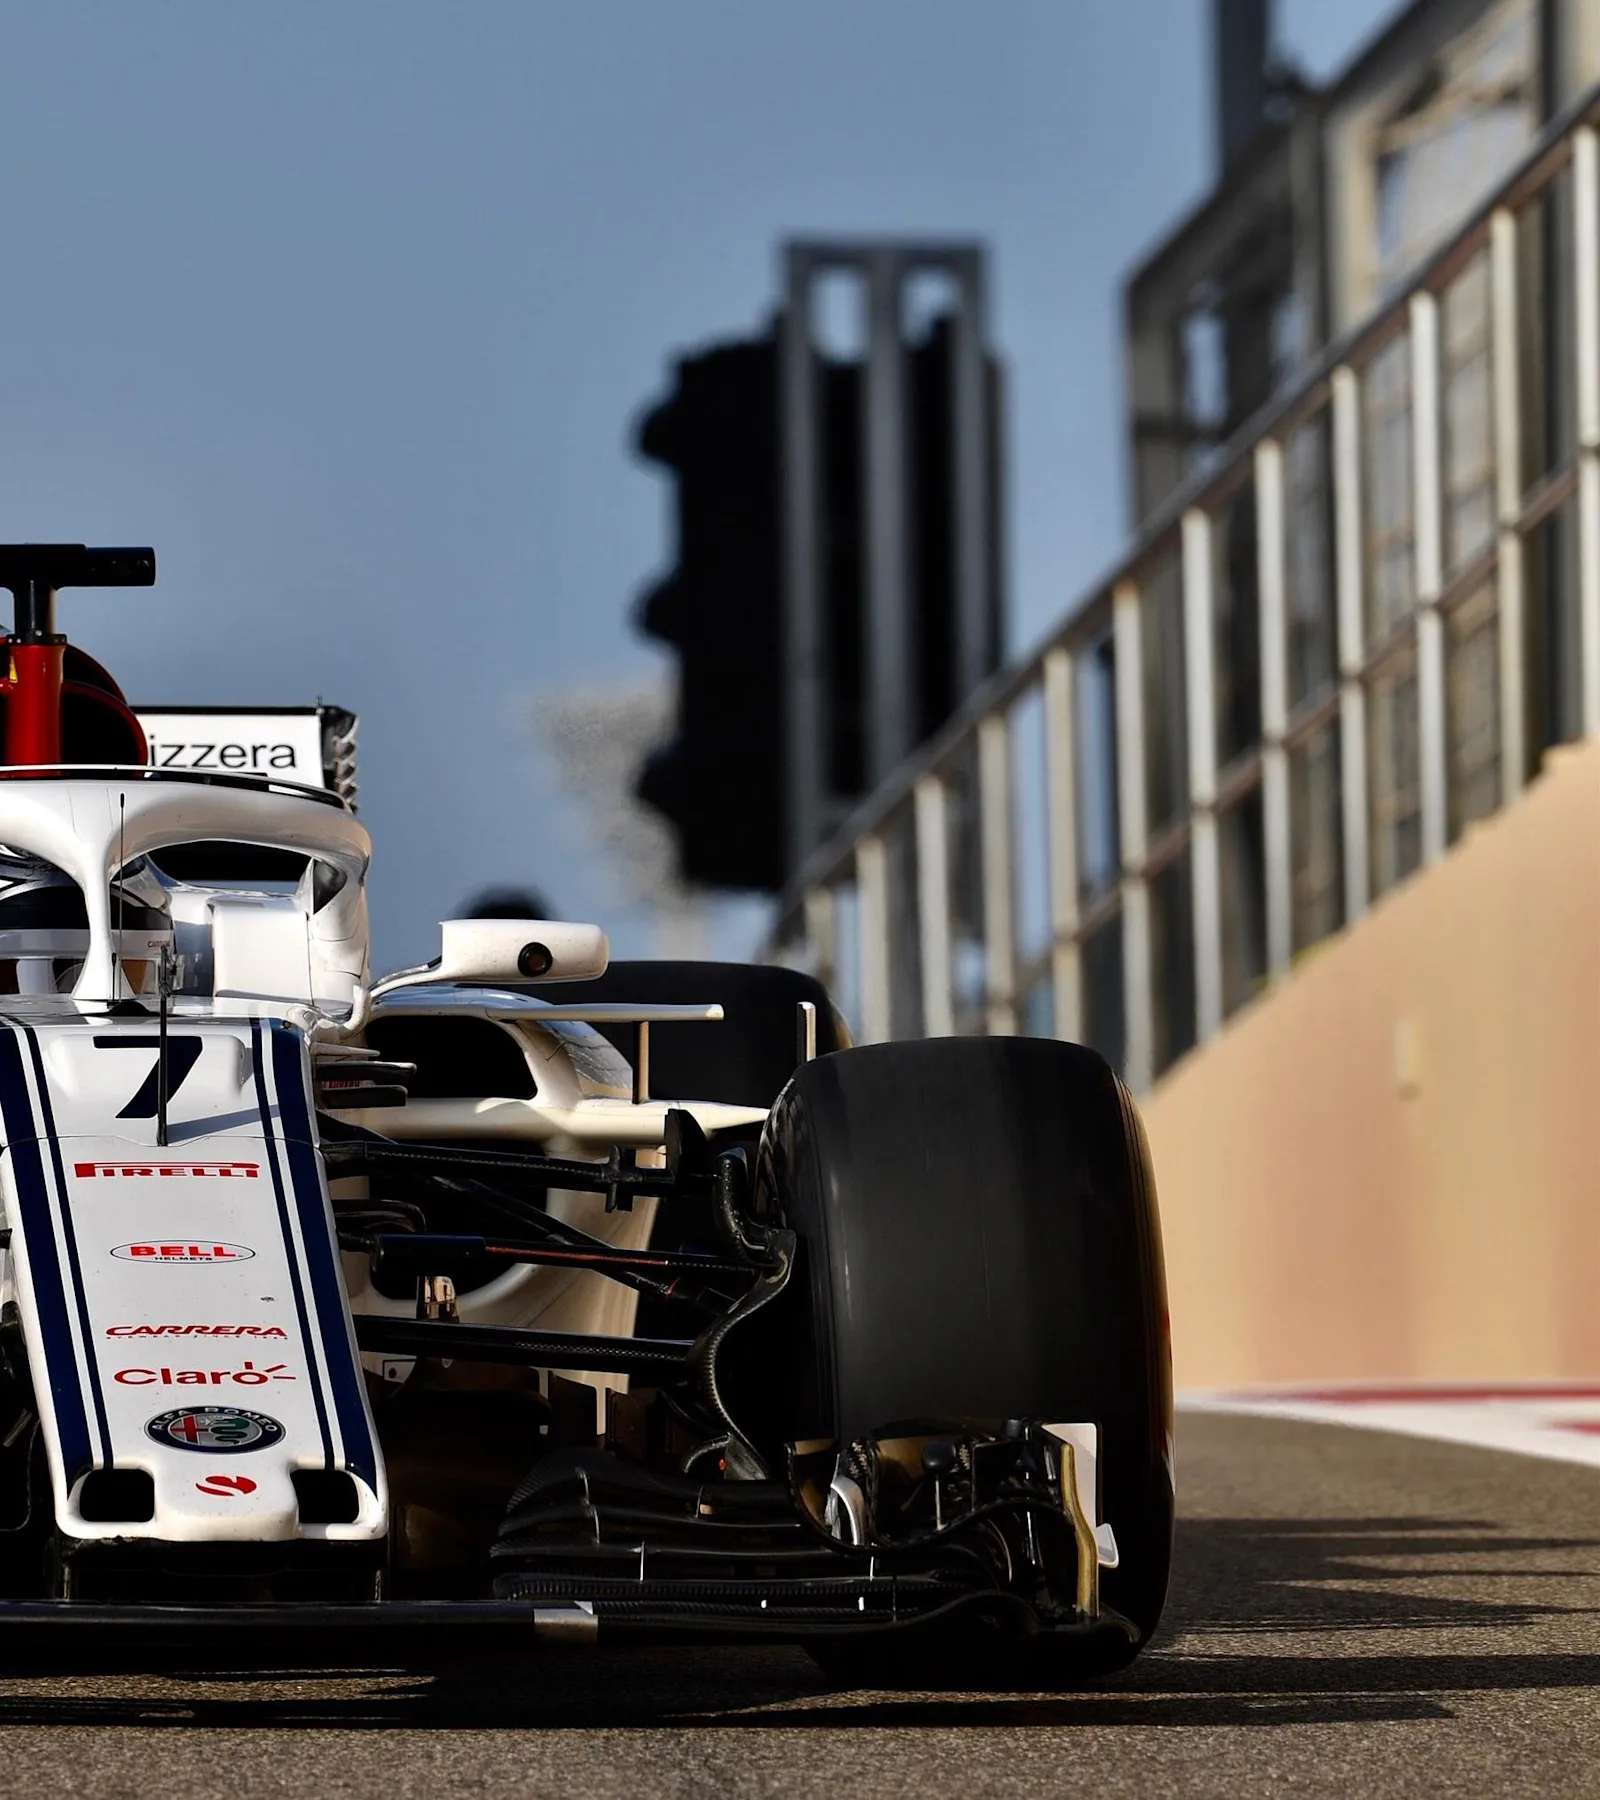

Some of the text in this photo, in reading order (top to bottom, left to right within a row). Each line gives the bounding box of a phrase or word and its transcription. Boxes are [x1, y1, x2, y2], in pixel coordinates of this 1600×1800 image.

[92, 1035, 203, 1119] 7
[129, 1245, 237, 1257] BELL
[105, 1325, 288, 1337] CARRERA
[113, 1363, 294, 1385] Claro
[151, 1406, 278, 1432] ALFA ROMEO
